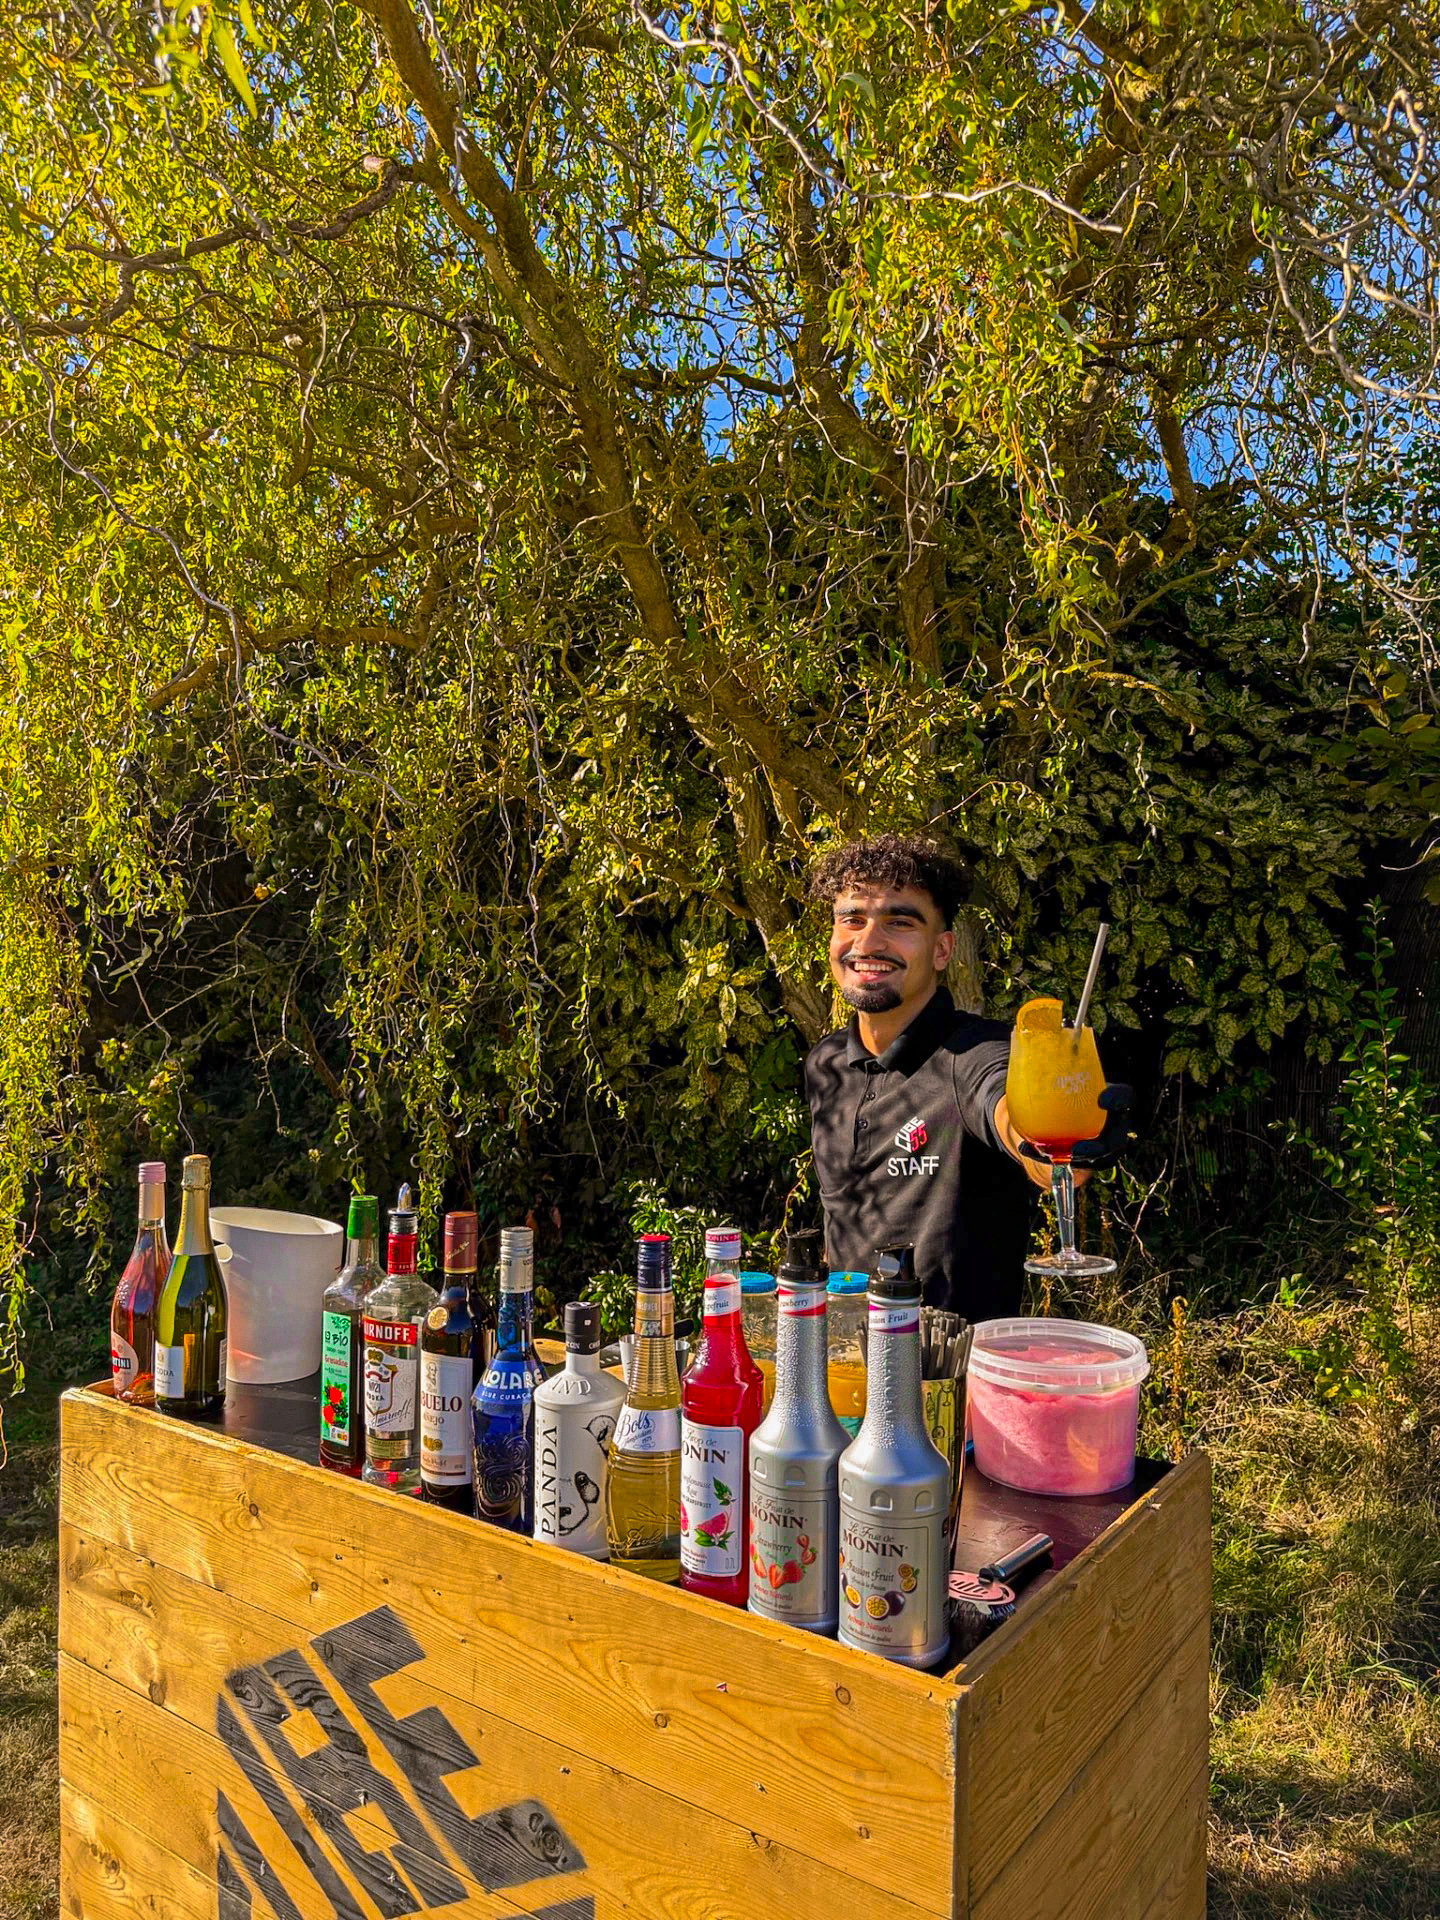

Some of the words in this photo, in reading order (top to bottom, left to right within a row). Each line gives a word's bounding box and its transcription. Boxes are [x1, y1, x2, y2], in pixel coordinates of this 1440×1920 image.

[894, 1116, 925, 1153] CUBE
[910, 1123, 928, 1151] 55
[887, 1155, 940, 1177] STAFF
[888, 1311, 908, 1323] Fruit
[483, 1369, 544, 1389] VOLARE
[617, 1409, 650, 1443] Bols
[682, 1440, 726, 1464] ONIN
[706, 1438, 717, 1446] de
[541, 1425, 558, 1539] PANDA
[750, 1501, 804, 1529] MONIN
[763, 1499, 783, 1514] Fruit
[784, 1506, 795, 1515] de
[842, 1528, 904, 1558] MONIN
[860, 1525, 881, 1541] Fruit
[883, 1533, 894, 1543] de
[871, 1567, 894, 1583] Fruit
